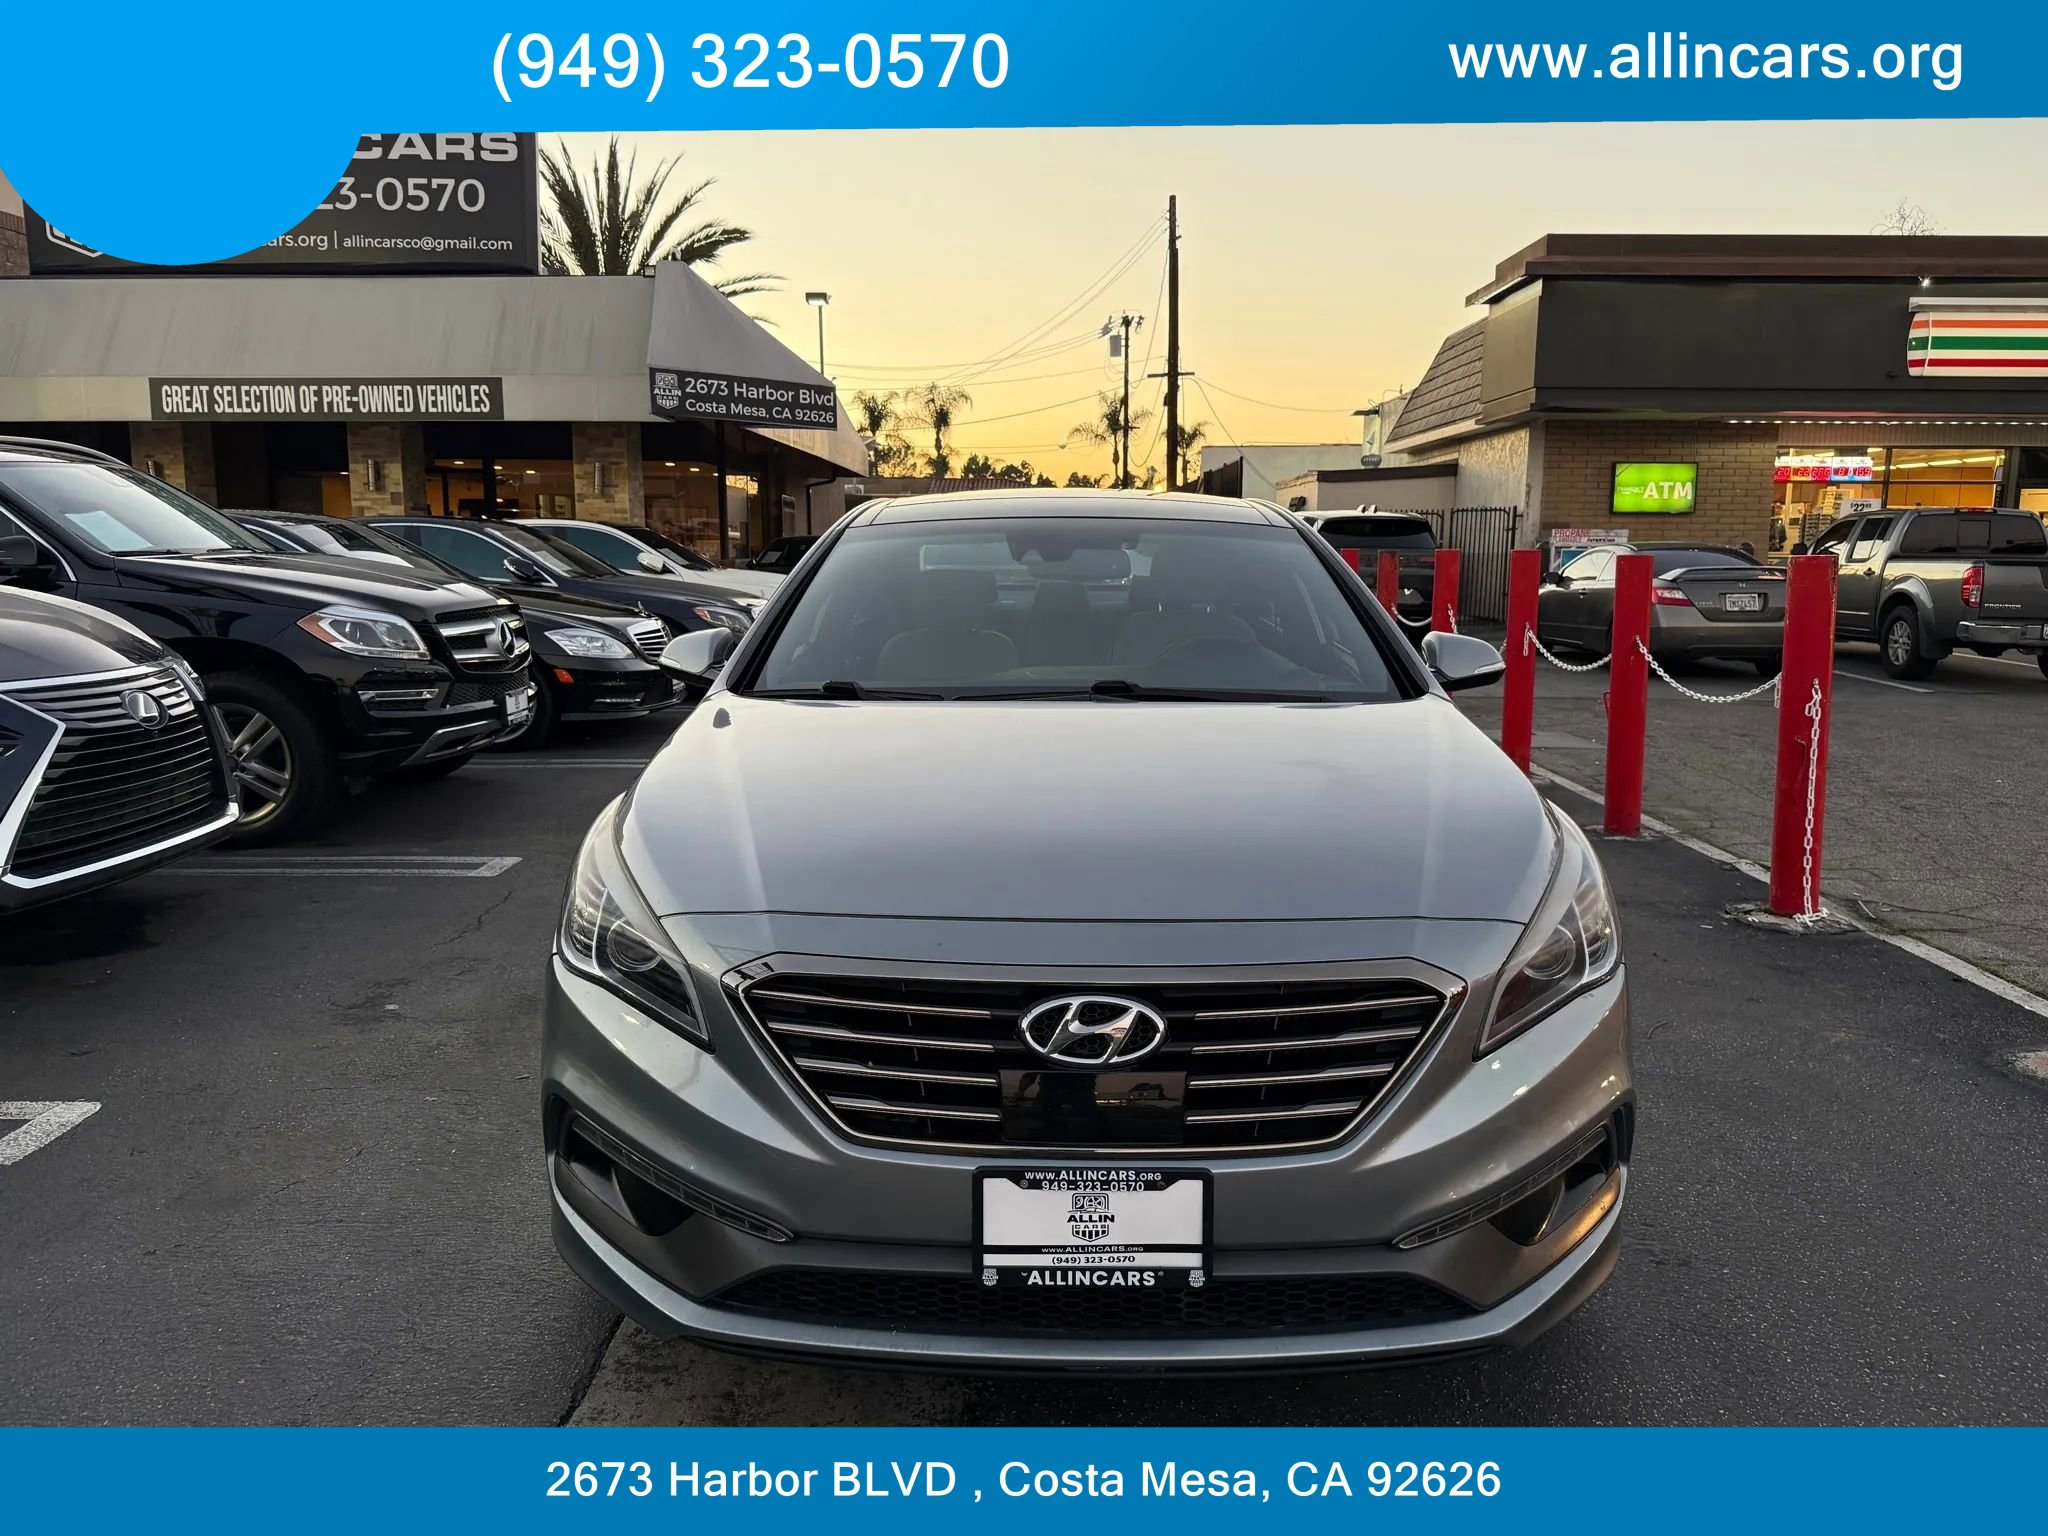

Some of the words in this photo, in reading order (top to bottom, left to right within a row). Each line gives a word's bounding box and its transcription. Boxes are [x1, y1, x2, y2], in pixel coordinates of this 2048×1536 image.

[315, 176, 486, 212] 3-0570
[260, 234, 329, 250] ars.org
[343, 236, 513, 251] allincarsco@gmail.com
[161, 385, 210, 413] GREAT
[213, 385, 297, 414] SELECTION
[300, 385, 319, 413] OF
[322, 384, 414, 413] PRE-OWNED
[416, 384, 491, 413] VEHICLES
[653, 387, 682, 397] ALLIN
[684, 377, 729, 396] 2673
[733, 382, 796, 403] Harbor
[799, 389, 835, 407] Blvd
[685, 399, 727, 414] Costa
[730, 404, 769, 419] Mesa,
[772, 407, 792, 420] CA
[795, 410, 835, 424] 92626
[1642, 481, 1693, 500] ATM
[1041, 1181, 1145, 1192] 949-323-0570
[1067, 1214, 1115, 1223] ALLIN
[1051, 1256, 1082, 1265] (949)
[1084, 1255, 1136, 1264] 323-0570
[1027, 1270, 1156, 1286] ALLINCARS
